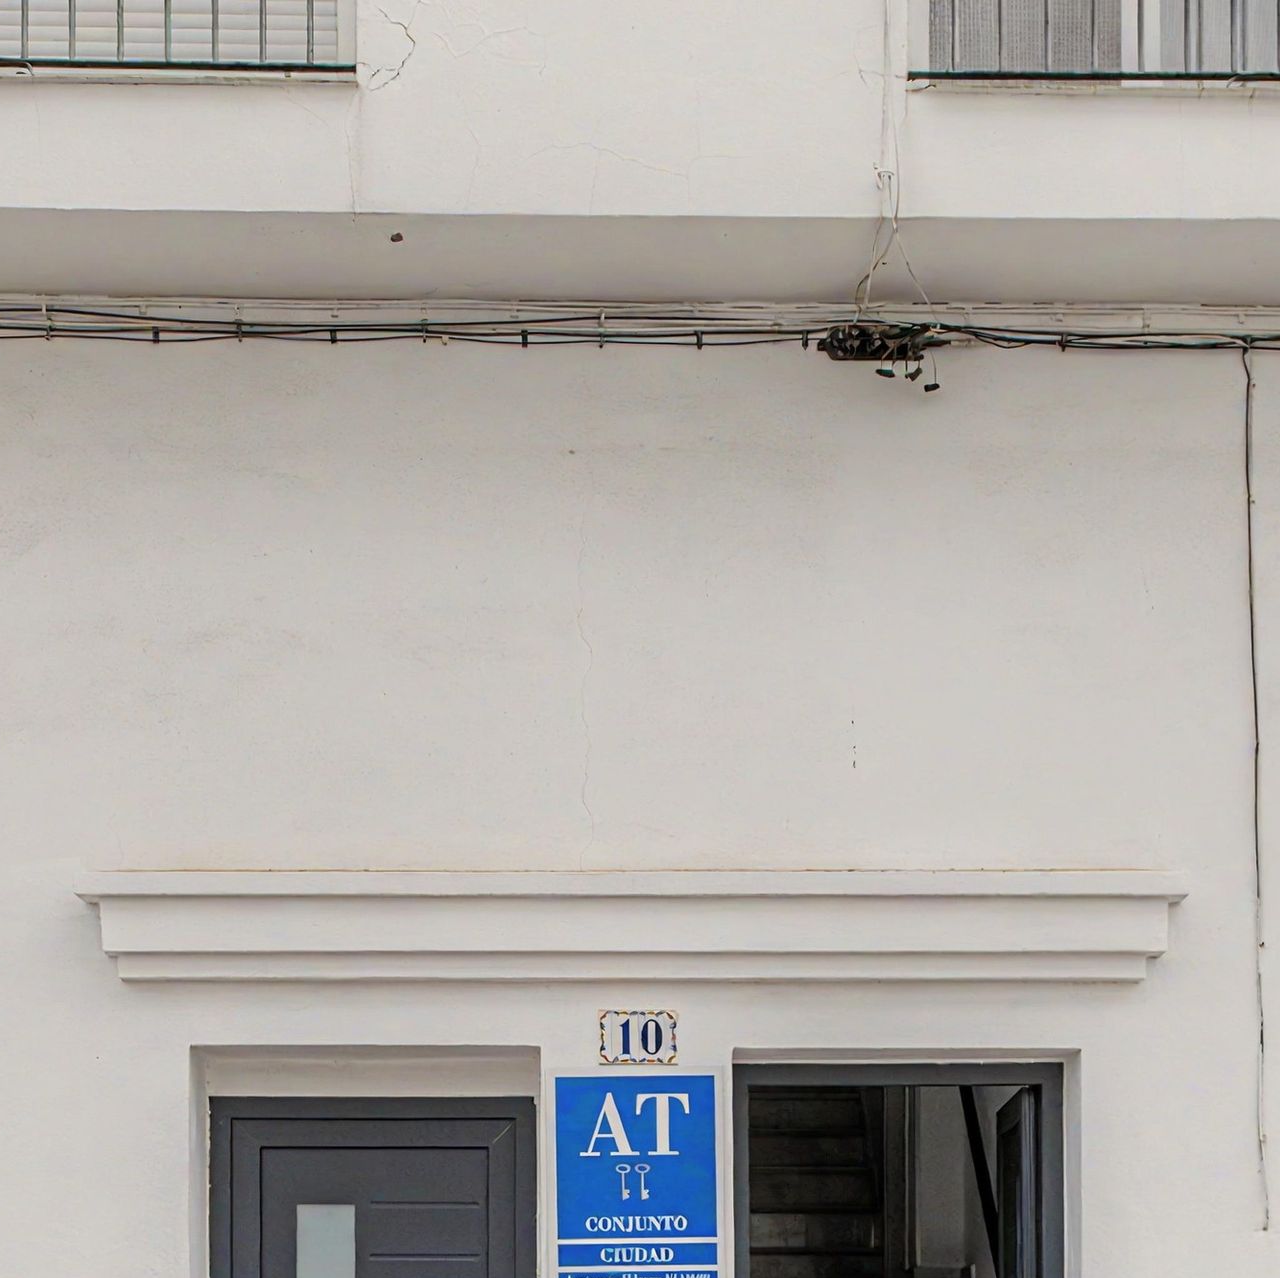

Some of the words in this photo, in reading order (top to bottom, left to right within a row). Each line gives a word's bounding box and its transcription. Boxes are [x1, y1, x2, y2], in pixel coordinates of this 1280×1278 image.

[619, 1017, 664, 1056] 10
[579, 1091, 690, 1157] AT
[585, 1215, 688, 1232] CONJUNTO
[600, 1247, 674, 1263] CIUDAD
